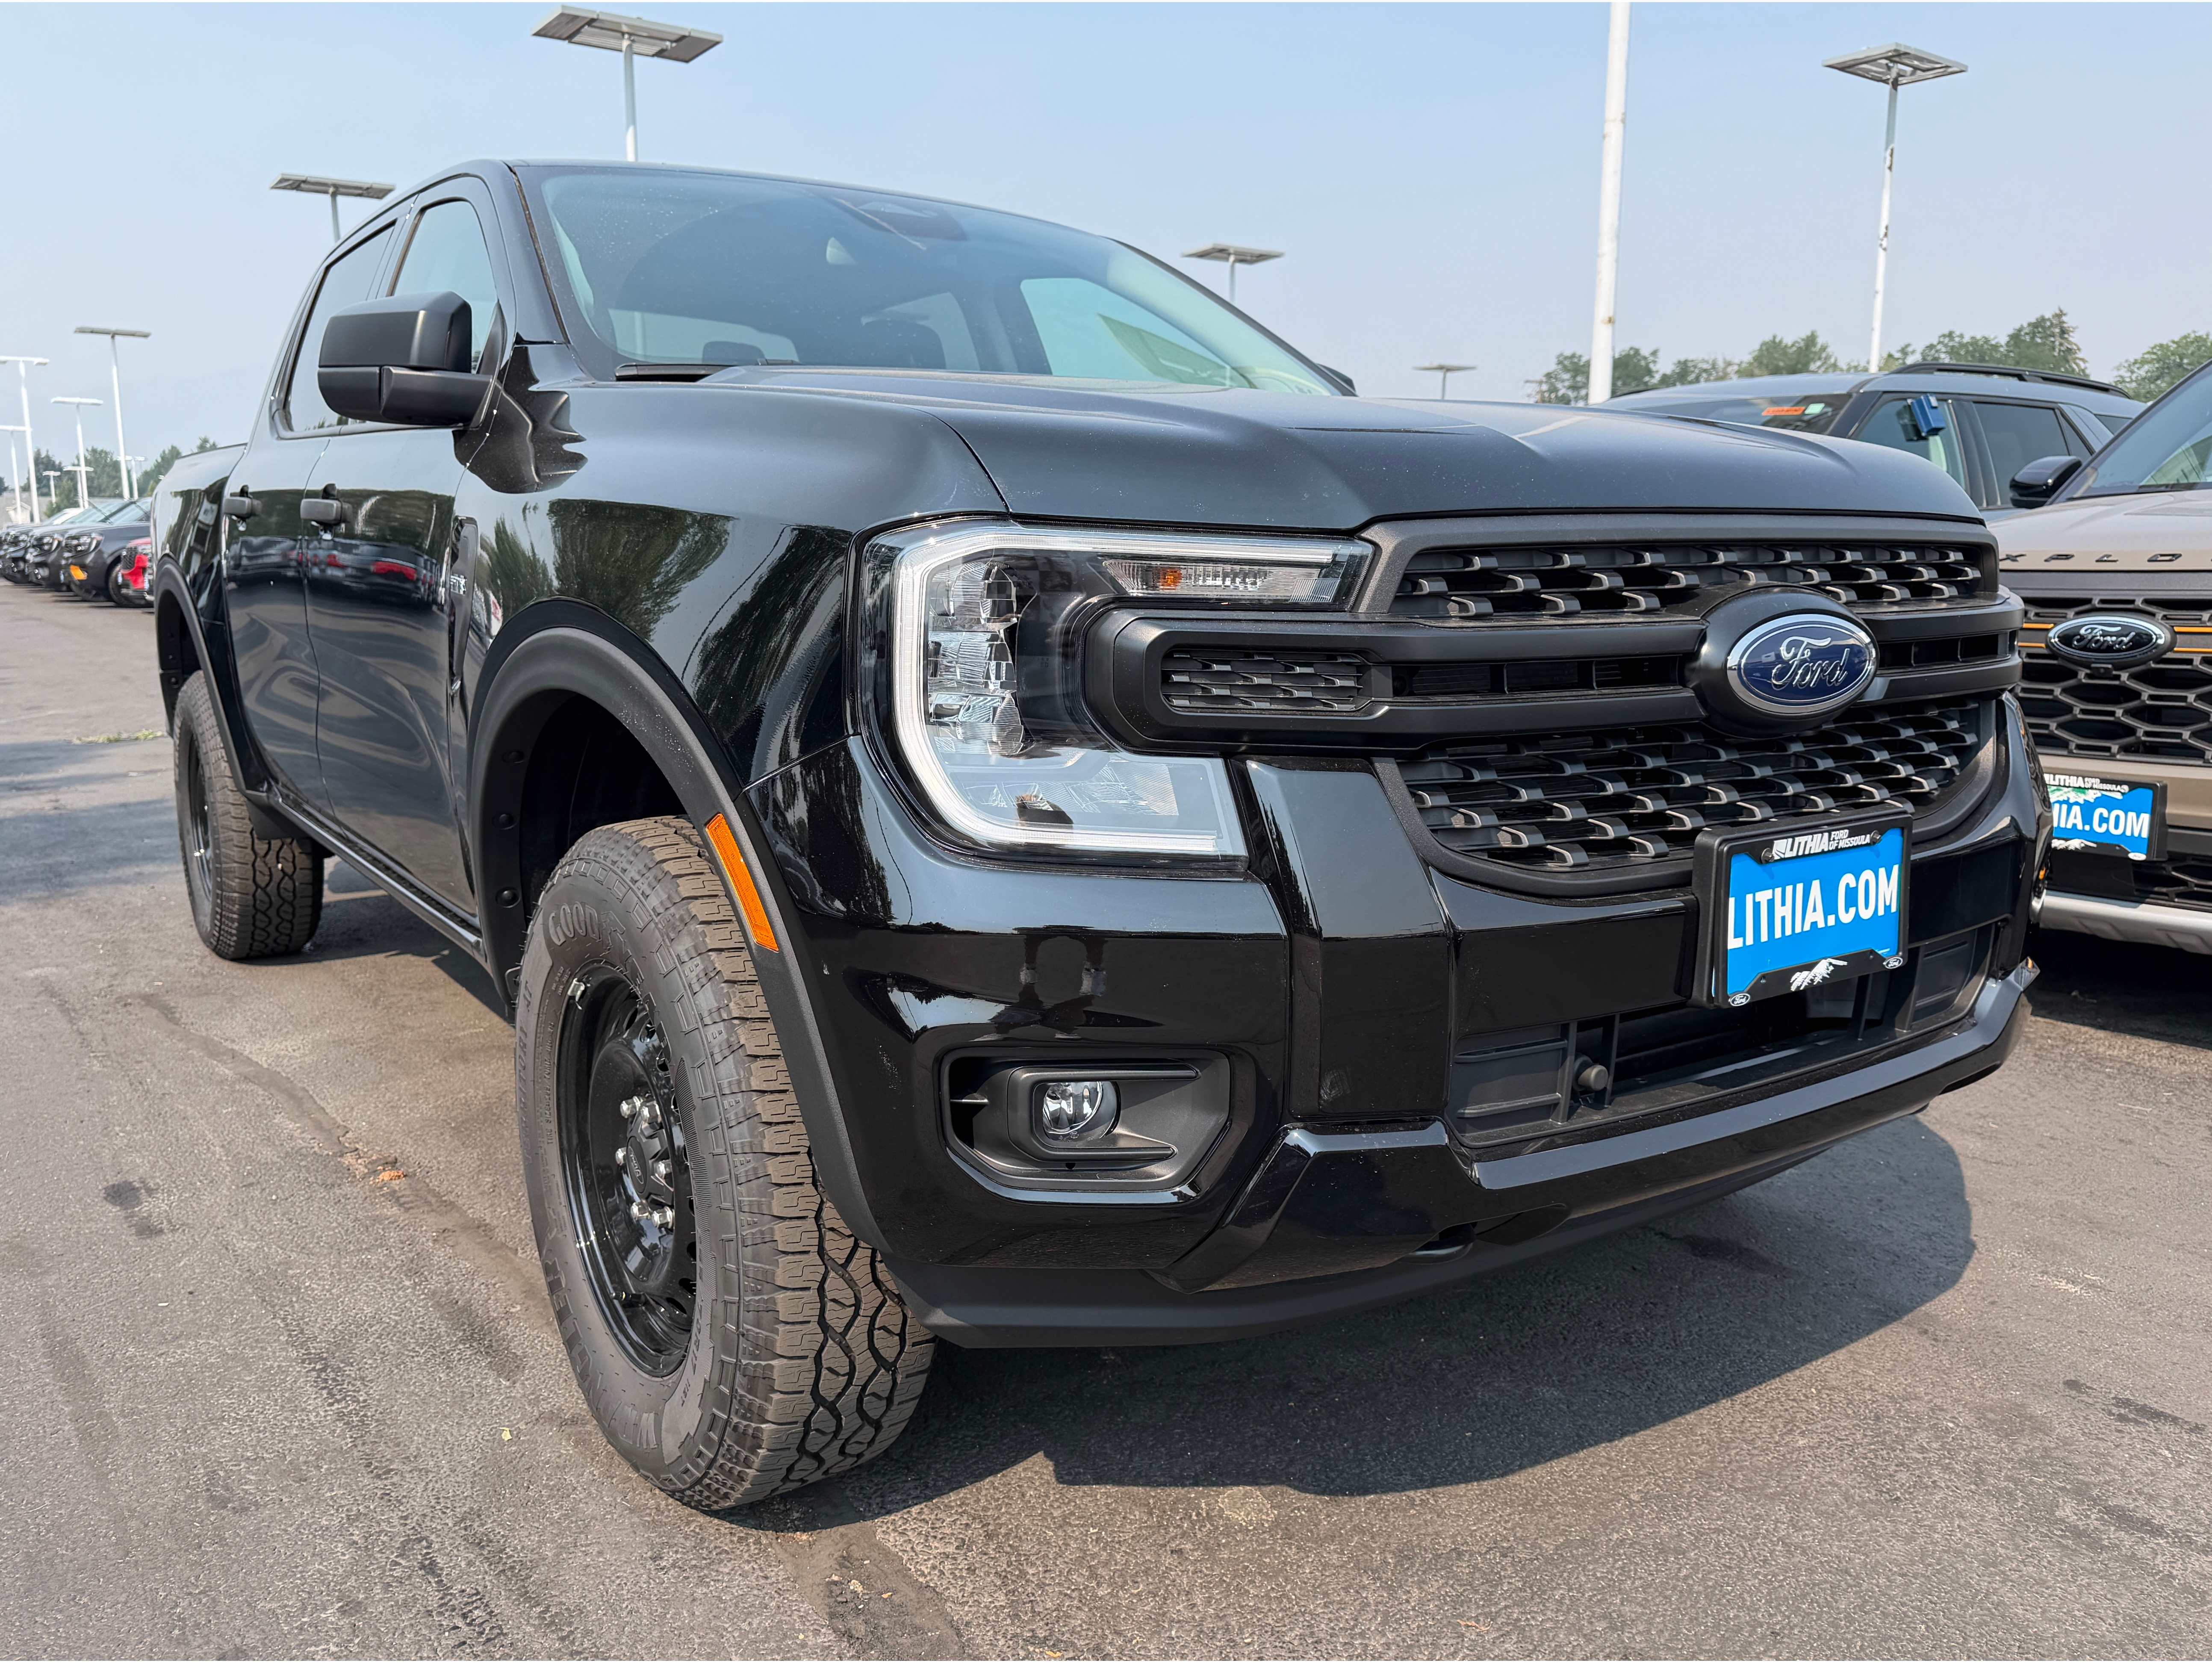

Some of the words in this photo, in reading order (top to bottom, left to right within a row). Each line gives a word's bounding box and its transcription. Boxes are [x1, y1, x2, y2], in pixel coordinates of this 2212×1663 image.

[2072, 624, 2136, 650] Ford
[1771, 636, 1850, 690] Ford
[1784, 832, 1829, 858] LITHIA
[1830, 829, 1849, 841] FORD
[1829, 840, 1838, 851] OF
[1838, 834, 1871, 849] MISSOULA
[1727, 864, 1899, 949] LITHIA.COM
